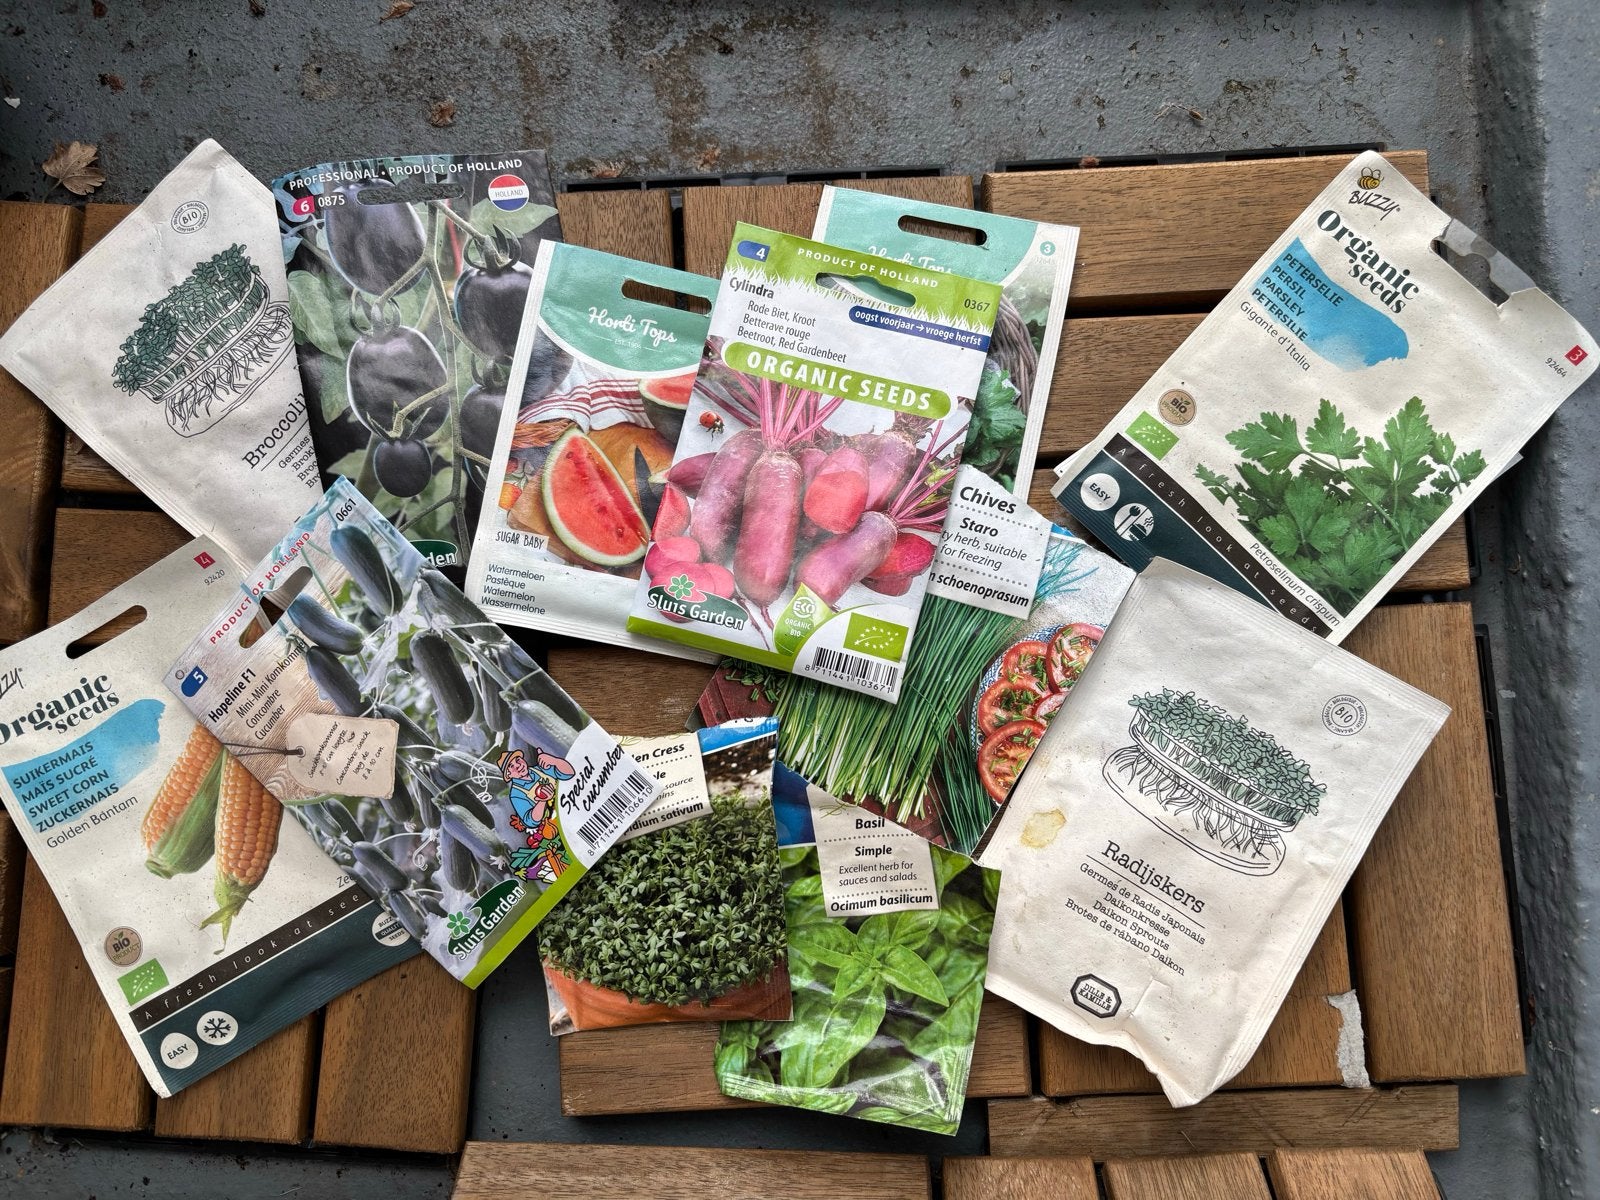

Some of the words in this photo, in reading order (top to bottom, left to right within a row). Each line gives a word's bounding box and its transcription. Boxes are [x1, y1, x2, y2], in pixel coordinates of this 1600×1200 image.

[289, 168, 379, 191] PROFESSIONAL
[389, 164, 445, 177] PRODUCT
[449, 163, 464, 174] OF
[467, 158, 523, 172] HOLLAND
[300, 200, 310, 212] 6
[317, 194, 345, 208] 0875
[494, 188, 524, 198] HOLLAND
[182, 211, 198, 224] BIO
[755, 248, 766, 260] 4
[1044, 243, 1052, 254] 3
[1317, 210, 1420, 301] Organic
[797, 248, 855, 268] PRODUCT
[859, 262, 876, 273] OF
[880, 267, 939, 288] HOLLAND
[1283, 253, 1344, 307] PETERSELIE
[729, 277, 774, 299] Cylindra
[1272, 265, 1307, 300] PERSIL
[1348, 263, 1406, 314] seeds
[964, 298, 990, 312] 0367
[1262, 277, 1305, 317] PARSLEY
[588, 307, 636, 333] Horti
[640, 321, 677, 347] Tops
[743, 313, 784, 333] Betterave
[785, 325, 811, 341] rouge
[747, 300, 769, 316] Rode
[771, 306, 790, 322] Biet,
[793, 311, 817, 327] Kroot
[1240, 301, 1278, 338] Gigante
[1252, 288, 1308, 342] PETERSILIE
[855, 309, 879, 323] oogst
[880, 315, 914, 332] voorjaar
[925, 325, 954, 342] vroege
[955, 330, 982, 346] herfst
[737, 325, 775, 346] Beetroot,
[778, 337, 795, 351] Red
[796, 342, 847, 364] Gardenbeet
[1569, 349, 1583, 361] 3
[747, 351, 853, 393] ORGANIC
[858, 379, 932, 411] SEEDS
[1545, 357, 1568, 378] 92464
[1171, 397, 1187, 414] BIO
[242, 392, 308, 469] Broccoli
[278, 436, 311, 469] Germes
[290, 446, 316, 471] Brok
[297, 460, 318, 481] Broc
[305, 472, 322, 488] Bro
[960, 486, 1017, 514] Chives
[1089, 483, 1112, 502] EASY
[335, 498, 357, 522] 0661
[495, 531, 520, 544] SUGAR
[523, 535, 545, 549] BABY
[960, 517, 999, 537] Staro
[1118, 447, 1127, 457] A
[1139, 463, 1187, 508] fresh
[1196, 516, 1234, 553] look
[1243, 561, 1260, 580] at
[1270, 587, 1319, 634] seeds
[940, 544, 957, 557] for
[957, 549, 1003, 571] freezing
[941, 530, 953, 542] ty
[954, 533, 981, 550] herb,
[983, 541, 1028, 561] suitable
[200, 554, 211, 566] 4
[488, 563, 545, 582] Watermeloen
[203, 568, 225, 586] 92420
[210, 595, 252, 645] PRODUCT
[252, 580, 266, 597] OF
[264, 531, 312, 580] HOLLAND
[485, 574, 526, 589] Pastèque
[936, 573, 1030, 607] schoenoprasum
[1250, 542, 1305, 597] Petroselinum
[1304, 592, 1341, 628] crispum
[481, 596, 546, 615] Wassermelone
[483, 585, 536, 602] Watermelon
[647, 593, 686, 616] Sluis
[689, 603, 746, 631] Garden
[784, 618, 812, 630] ORGANIC
[195, 671, 205, 684] 5
[804, 664, 811, 672] 8
[815, 666, 851, 682] 711441
[856, 677, 892, 693] 103671
[208, 681, 246, 723] Hopeline
[241, 668, 257, 684] F1
[236, 680, 270, 718] Mini-Mini
[245, 689, 281, 729] Concombre
[55, 692, 120, 734] seeds
[255, 704, 286, 740] Cucumber
[1335, 706, 1353, 723] BIO
[652, 743, 685, 758] Cress
[13, 741, 94, 789] SUIKERMAIS
[582, 744, 626, 812] cucumber
[21, 777, 55, 804] MAÏS
[55, 755, 99, 789] SUCRÉ
[560, 755, 596, 815] Special
[664, 777, 694, 790] source
[28, 791, 71, 819] SWEET
[72, 769, 109, 799] CORN
[37, 782, 119, 833] ZUCKERMAIS
[47, 819, 91, 850] Golden
[91, 795, 138, 826] Bantam
[587, 849, 595, 857] 8
[594, 818, 624, 848] 711441
[624, 787, 653, 816] 106610
[660, 802, 704, 822] sativum
[855, 816, 885, 830] Basil
[855, 845, 893, 858] Simple
[839, 863, 877, 875] Excellent
[879, 862, 899, 872] herb
[901, 860, 914, 870] for
[839, 876, 868, 887] sauces
[870, 873, 889, 884] and
[889, 872, 918, 882] salads
[1101, 840, 1206, 914] Radijskers
[830, 898, 877, 912] Ocimum
[879, 894, 933, 907] basilicum
[1079, 862, 1119, 893] Germes
[1117, 885, 1131, 900] de
[1131, 893, 1161, 918] Radis
[1161, 912, 1206, 946] Japonais
[1103, 891, 1171, 938] Daikonkresse
[378, 916, 394, 928] BUZZ
[381, 922, 400, 936] QUALIT
[453, 924, 486, 960] Sluis
[481, 886, 525, 931] Garden
[1092, 900, 1129, 929] Daikon
[1130, 921, 1170, 951] Sprouts
[112, 937, 131, 953] BIO
[1065, 898, 1099, 925] Brotes
[1099, 917, 1113, 932] de
[1114, 924, 1150, 953] rábano
[1150, 947, 1186, 977] Daikon
[112, 942, 140, 961] PRODUCT
[144, 1010, 153, 1020] A
[164, 974, 217, 1010] fresh
[232, 939, 278, 970] look
[294, 919, 313, 936] at
[328, 893, 360, 917] see
[1079, 988, 1112, 1011] KAMILLE
[1083, 983, 1105, 999] DILLE
[166, 1043, 189, 1061] EASY
